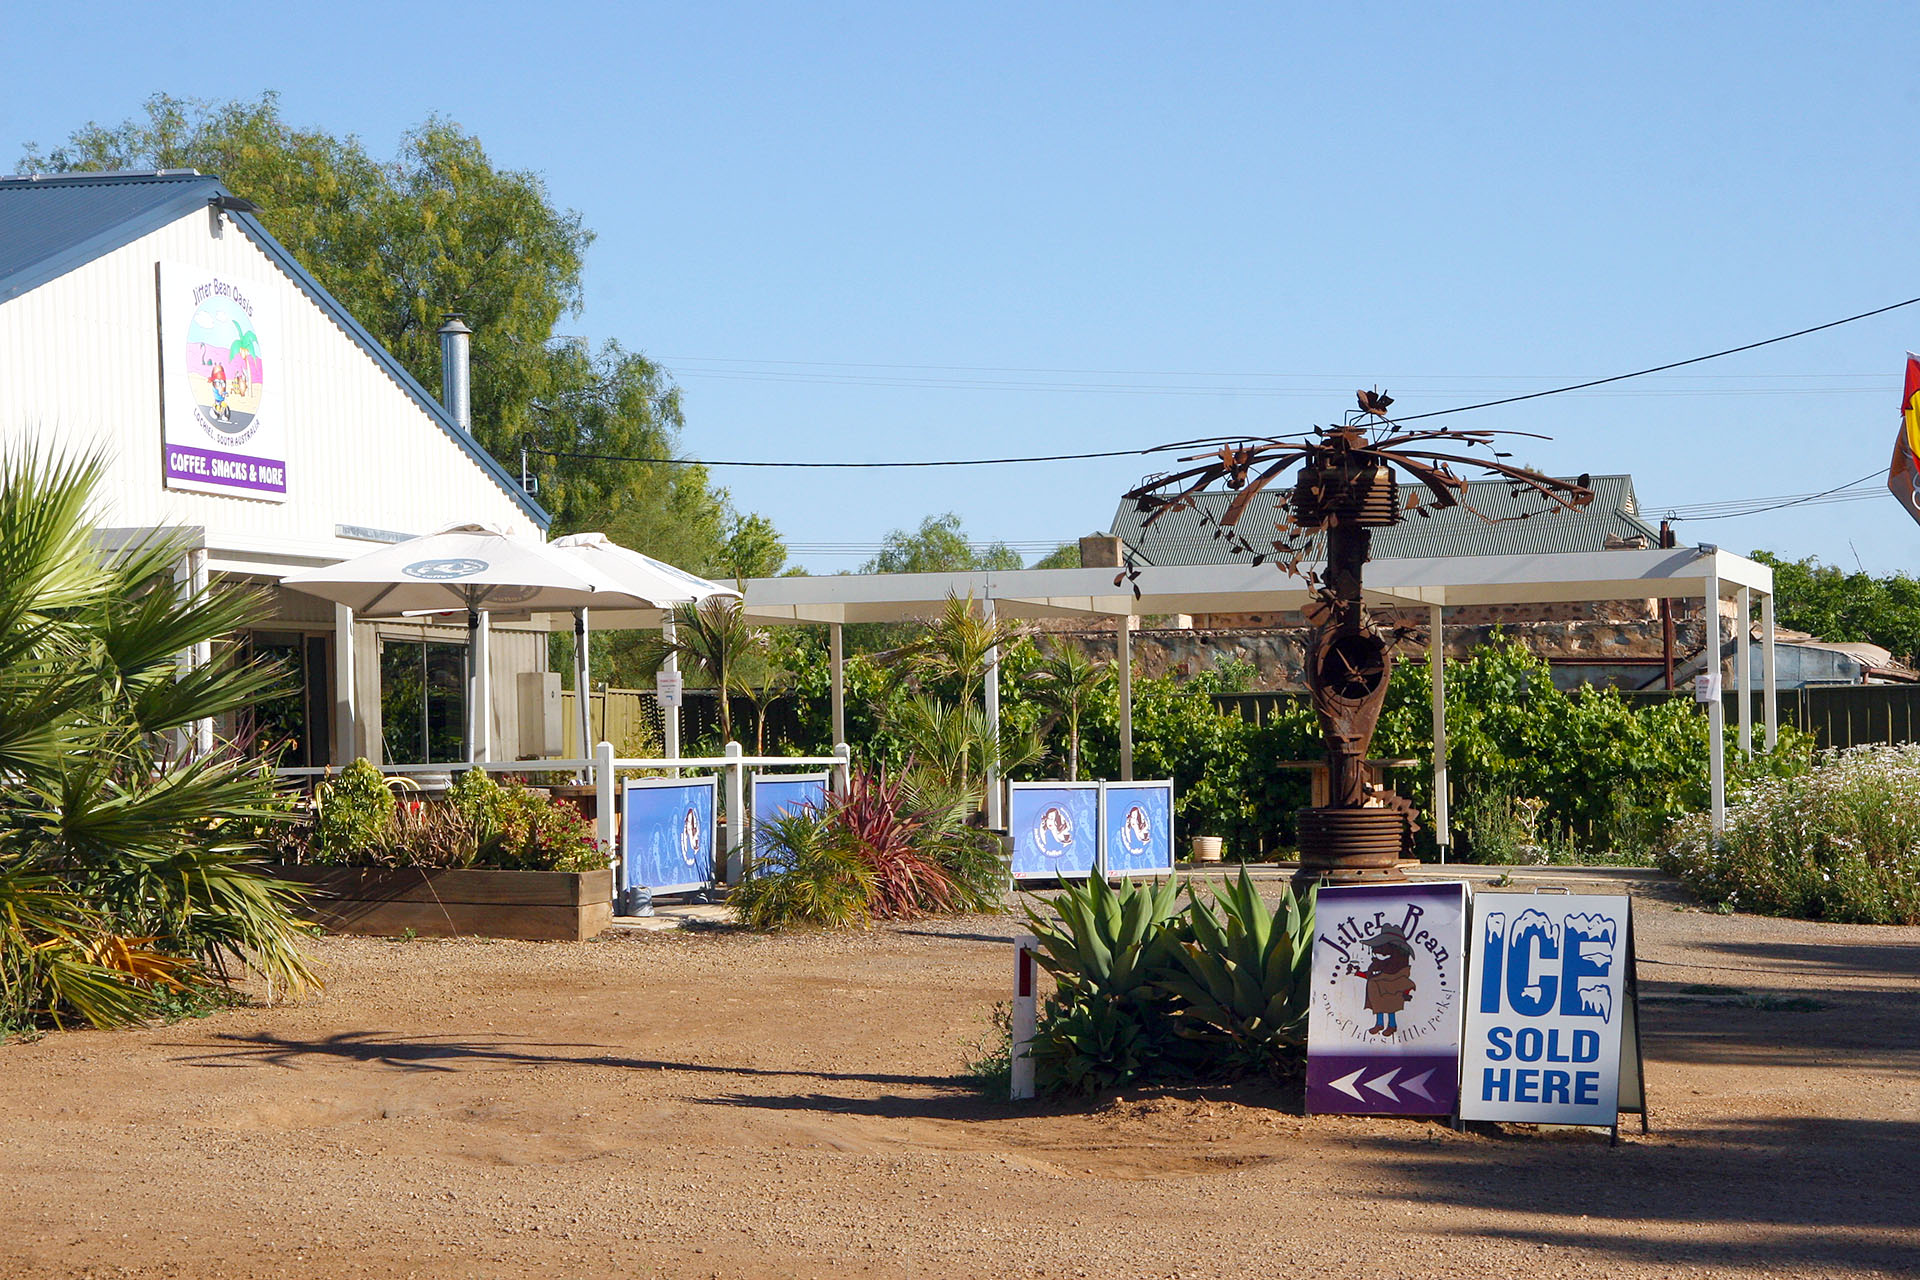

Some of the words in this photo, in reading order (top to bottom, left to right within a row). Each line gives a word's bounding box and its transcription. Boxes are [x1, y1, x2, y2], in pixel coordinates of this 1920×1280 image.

[193, 283, 211, 306] Jitter
[213, 278, 231, 297] Bean
[233, 286, 253, 317] Oasis
[217, 434, 233, 447] SOUTH
[234, 419, 260, 446] AUSTRALIA
[170, 452, 210, 476] COFFEE,
[211, 458, 247, 481] SNACKS
[249, 463, 257, 482] &
[258, 465, 284, 486] MORE
[1318, 911, 1385, 964] Jitter
[1401, 903, 1449, 967] Bean
[1480, 908, 1617, 1024] ICE
[1322, 993, 1335, 1017] one
[1335, 1018, 1353, 1032] of
[1391, 1025, 1428, 1044] little
[1486, 1026, 1600, 1063] SOLD
[1482, 1067, 1600, 1105] HERE
